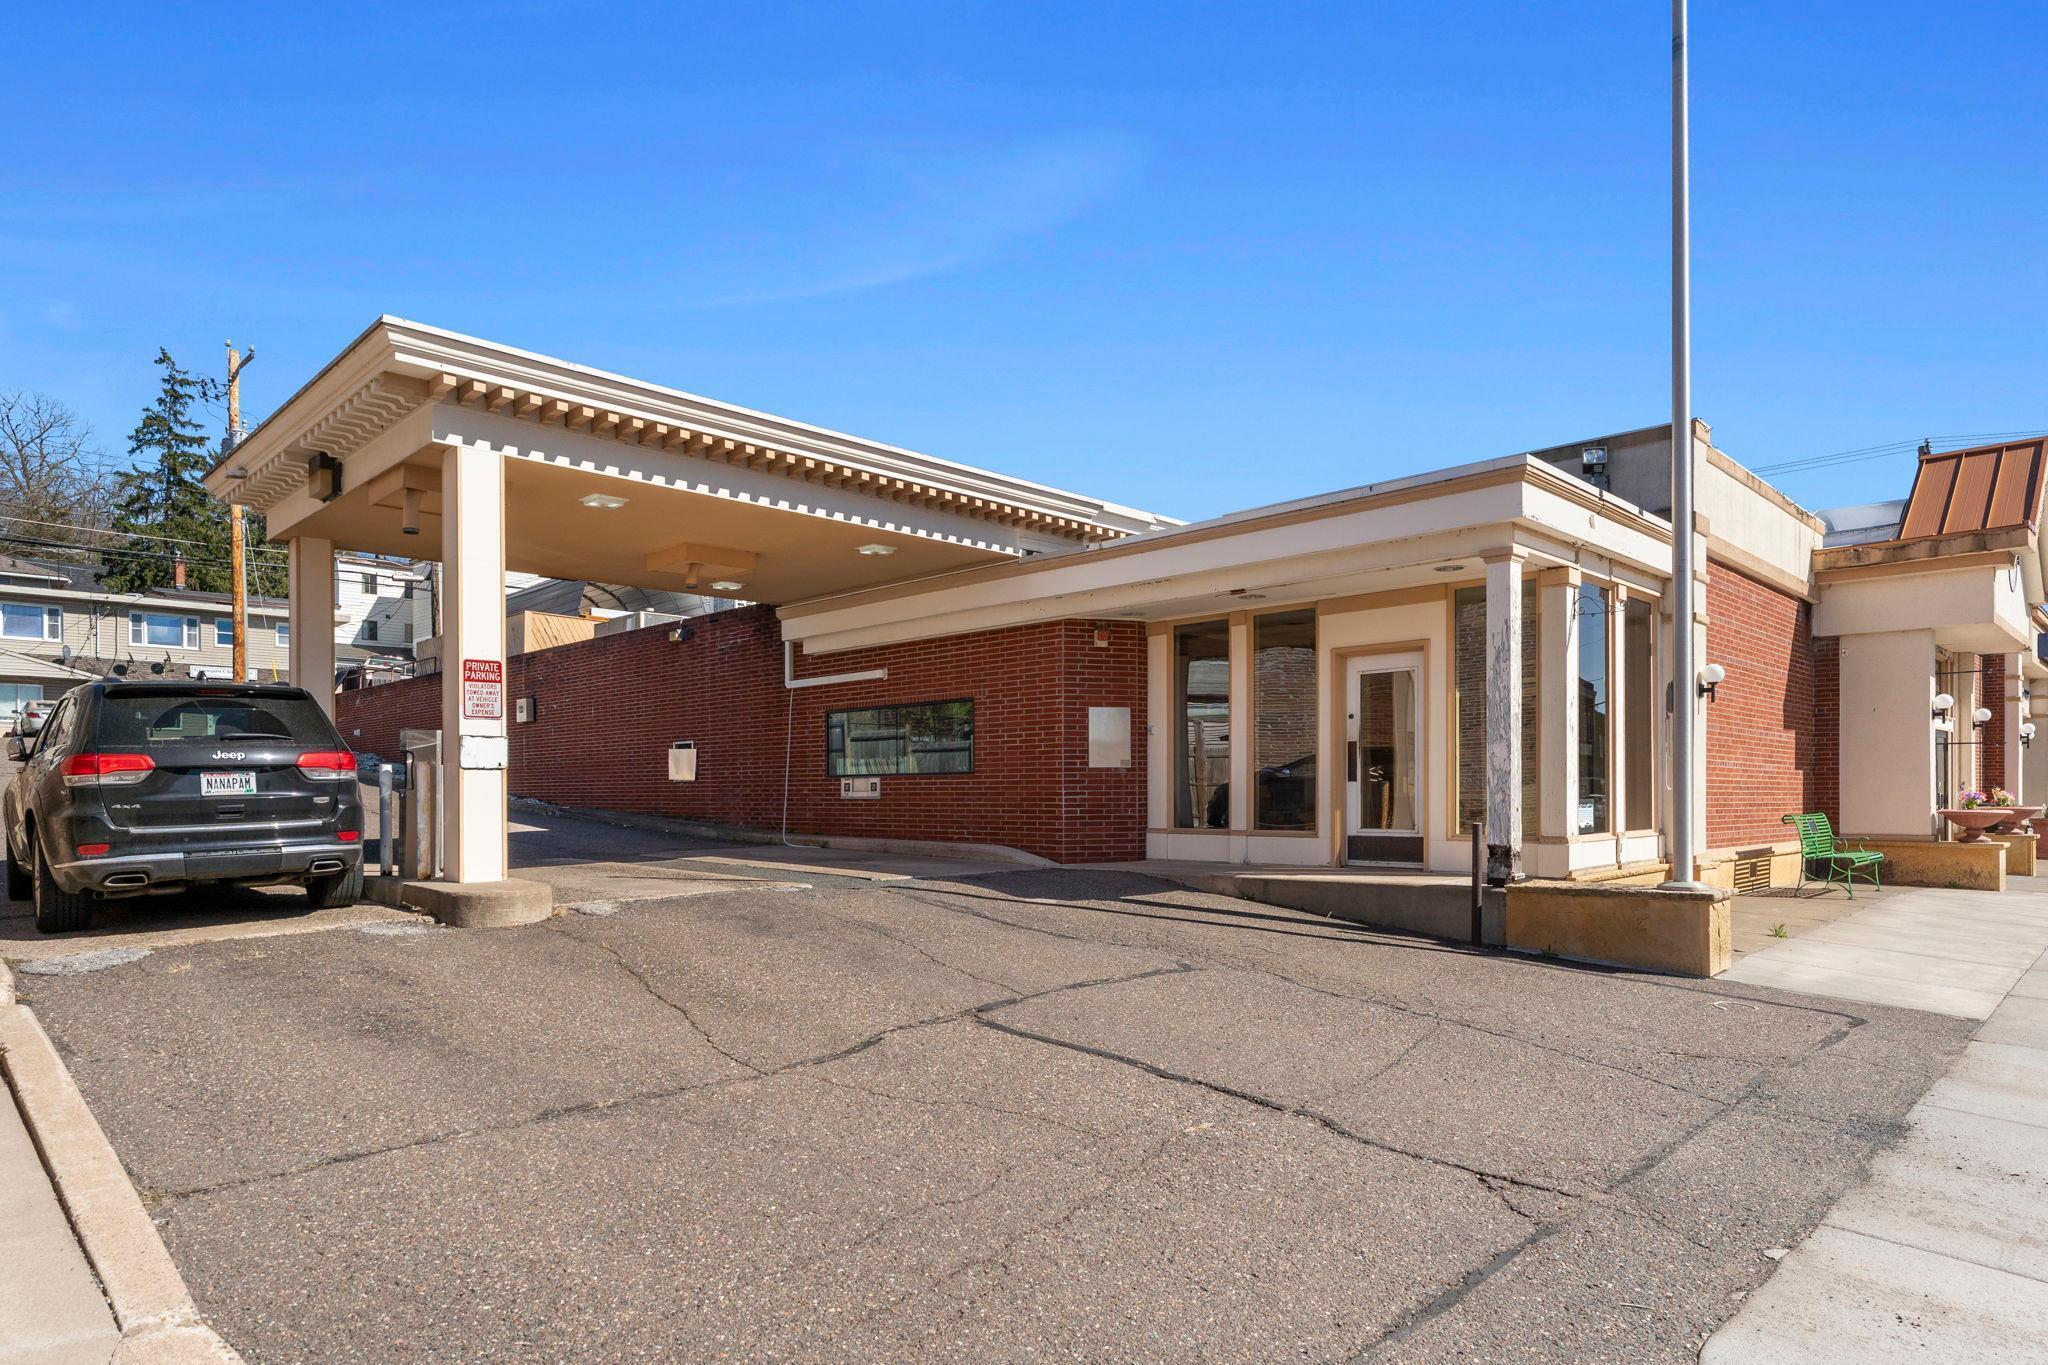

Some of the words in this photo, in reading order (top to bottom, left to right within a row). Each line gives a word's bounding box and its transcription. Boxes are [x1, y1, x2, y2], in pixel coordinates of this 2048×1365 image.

[466, 662, 499, 672] PRIVATE
[465, 671, 500, 680] PARKING
[212, 750, 246, 760] Jeep
[206, 777, 251, 789] NANAPAM
